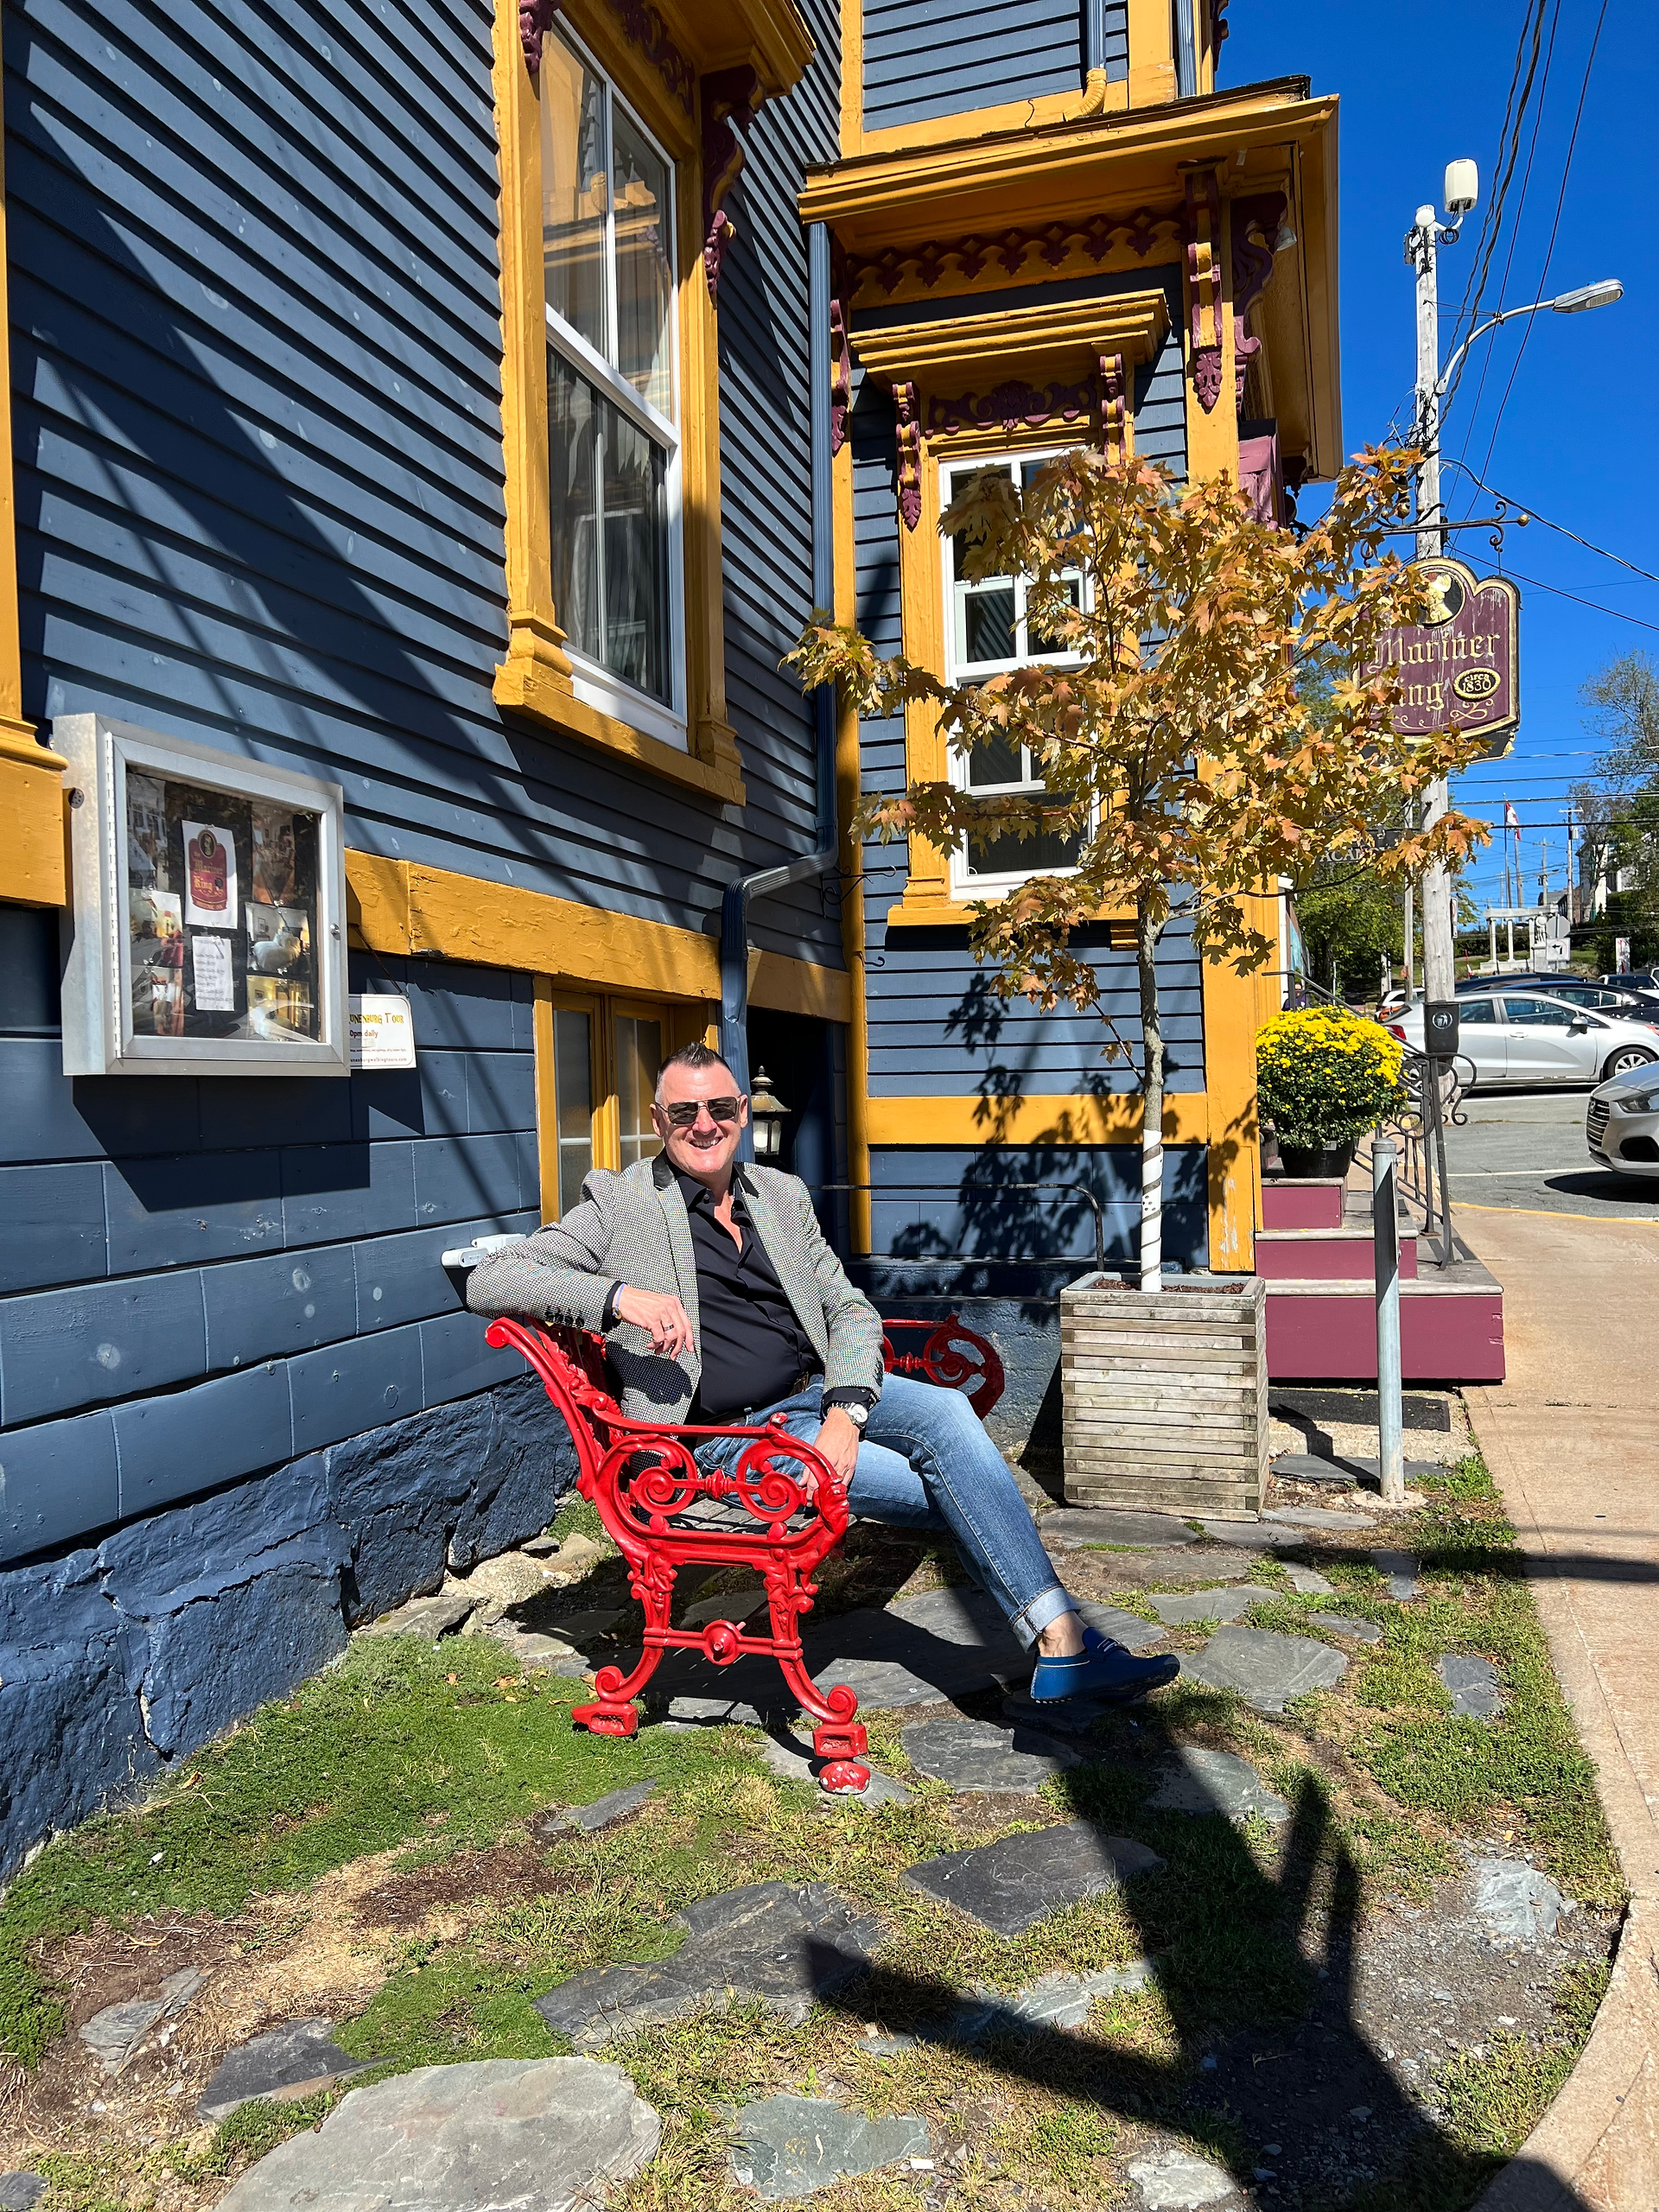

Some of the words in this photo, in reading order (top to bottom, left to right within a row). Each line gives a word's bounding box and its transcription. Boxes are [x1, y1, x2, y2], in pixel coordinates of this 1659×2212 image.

[1367, 632, 1500, 673] Mariner
[1464, 674, 1490, 683] circa
[1462, 679, 1491, 693] 1830
[1393, 678, 1445, 712] ing
[349, 1014, 383, 1025] UNENBURG
